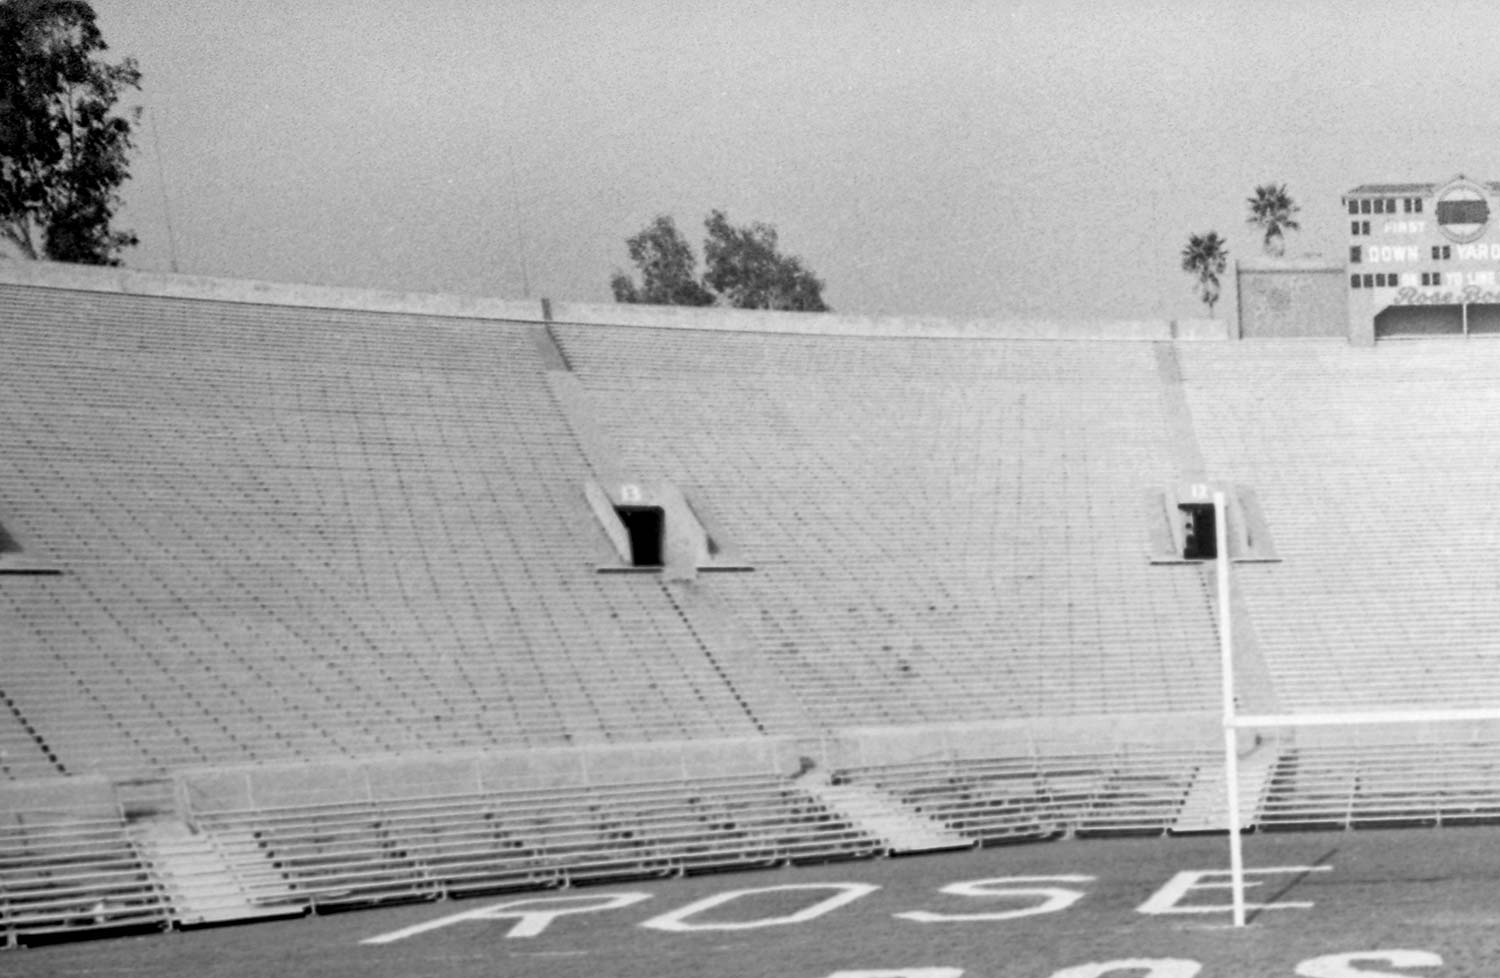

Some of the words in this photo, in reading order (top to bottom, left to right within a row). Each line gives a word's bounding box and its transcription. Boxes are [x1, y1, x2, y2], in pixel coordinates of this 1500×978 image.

[1384, 220, 1425, 233] FIRST
[1369, 244, 1419, 263] DOWN
[1393, 286, 1453, 304] Rose
[358, 865, 1334, 944] ROSE
